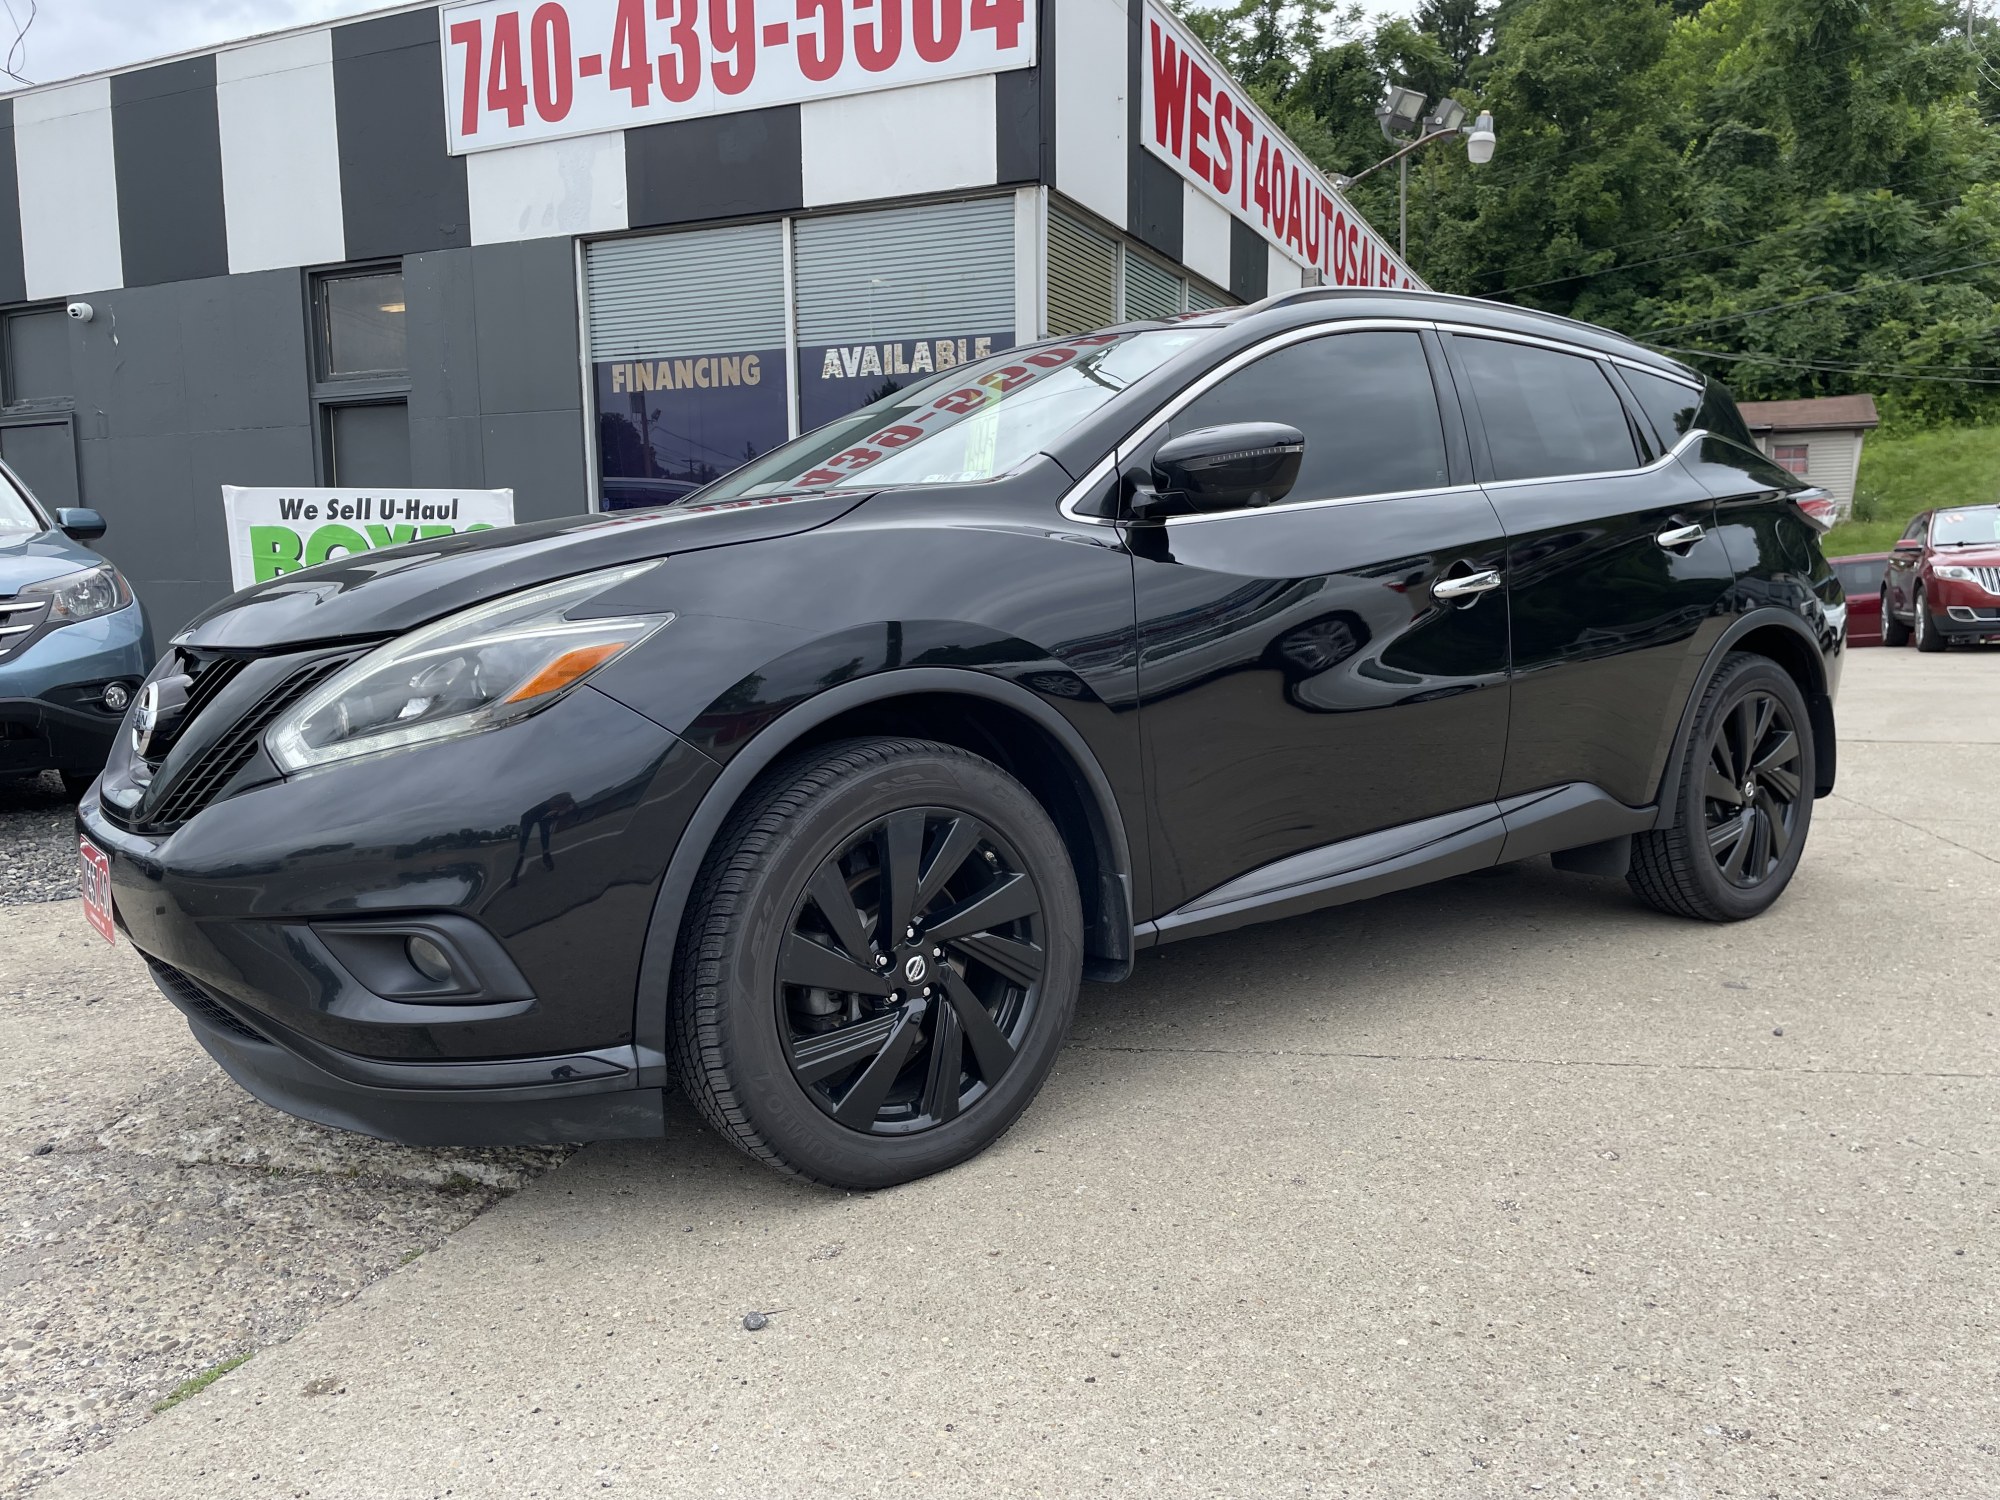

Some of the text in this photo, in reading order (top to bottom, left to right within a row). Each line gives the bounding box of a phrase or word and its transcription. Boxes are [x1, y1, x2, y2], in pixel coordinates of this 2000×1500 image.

[611, 337, 992, 393] FINANCING AVAILABLE
[279, 498, 458, 520] We Sell U-Haul
